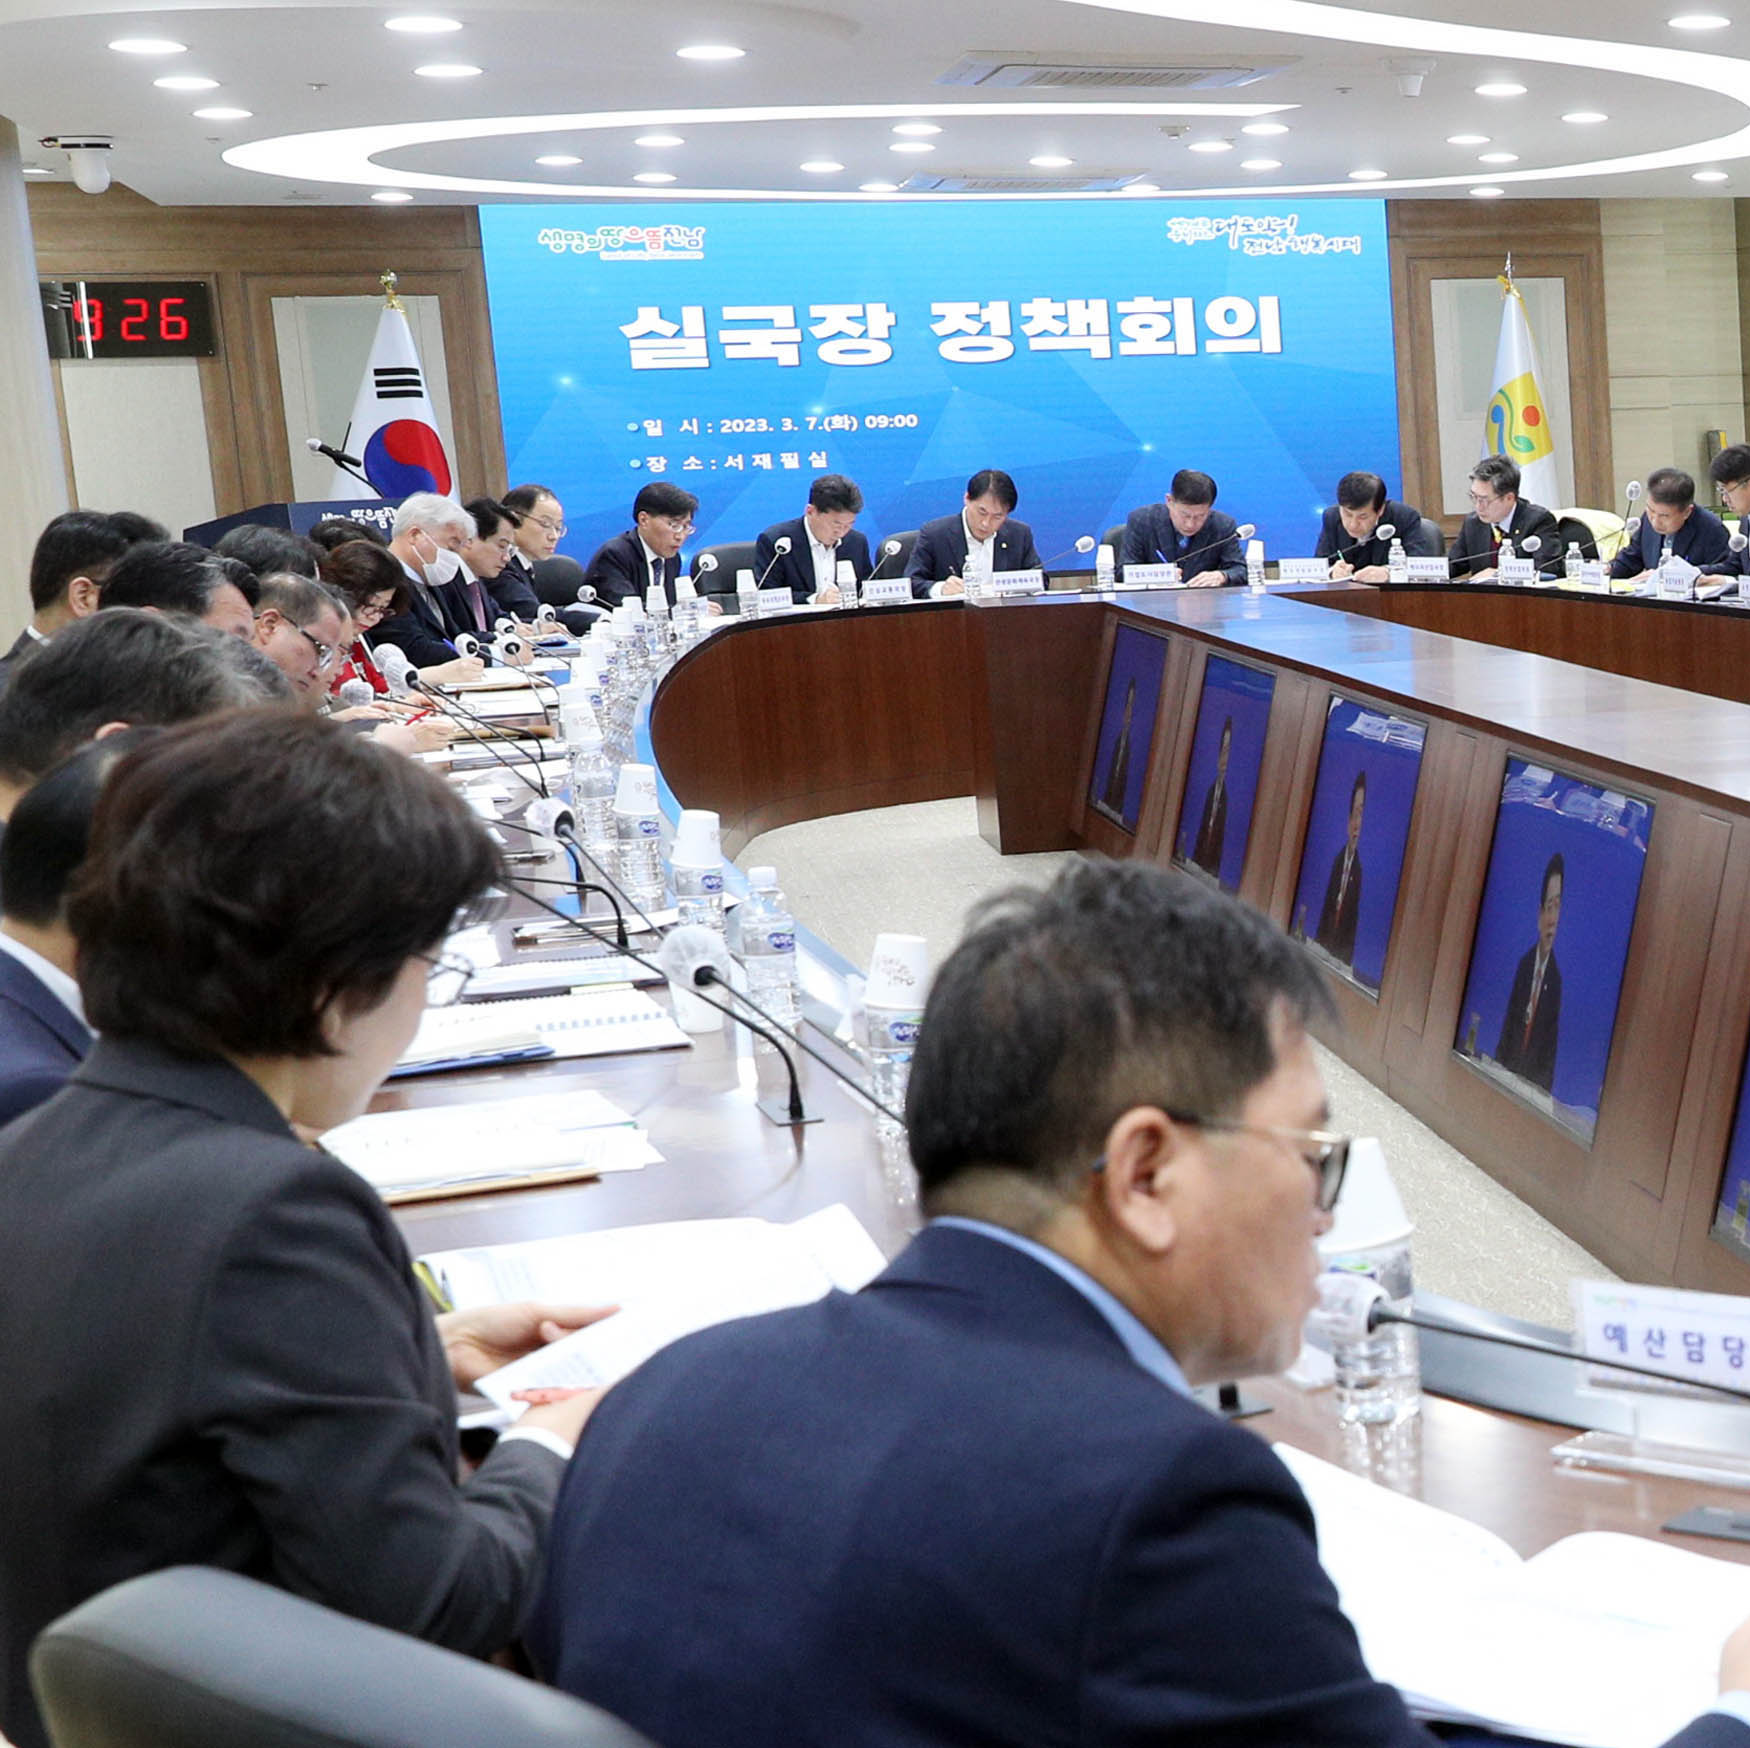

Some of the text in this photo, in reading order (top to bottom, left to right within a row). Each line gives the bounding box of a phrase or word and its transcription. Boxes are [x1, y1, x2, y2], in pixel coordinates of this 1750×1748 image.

[620, 296, 1282, 370] 실국장 정책회의
[720, 418, 775, 434] 2023.
[781, 418, 799, 432] 3.
[864, 414, 919, 429] 09:00
